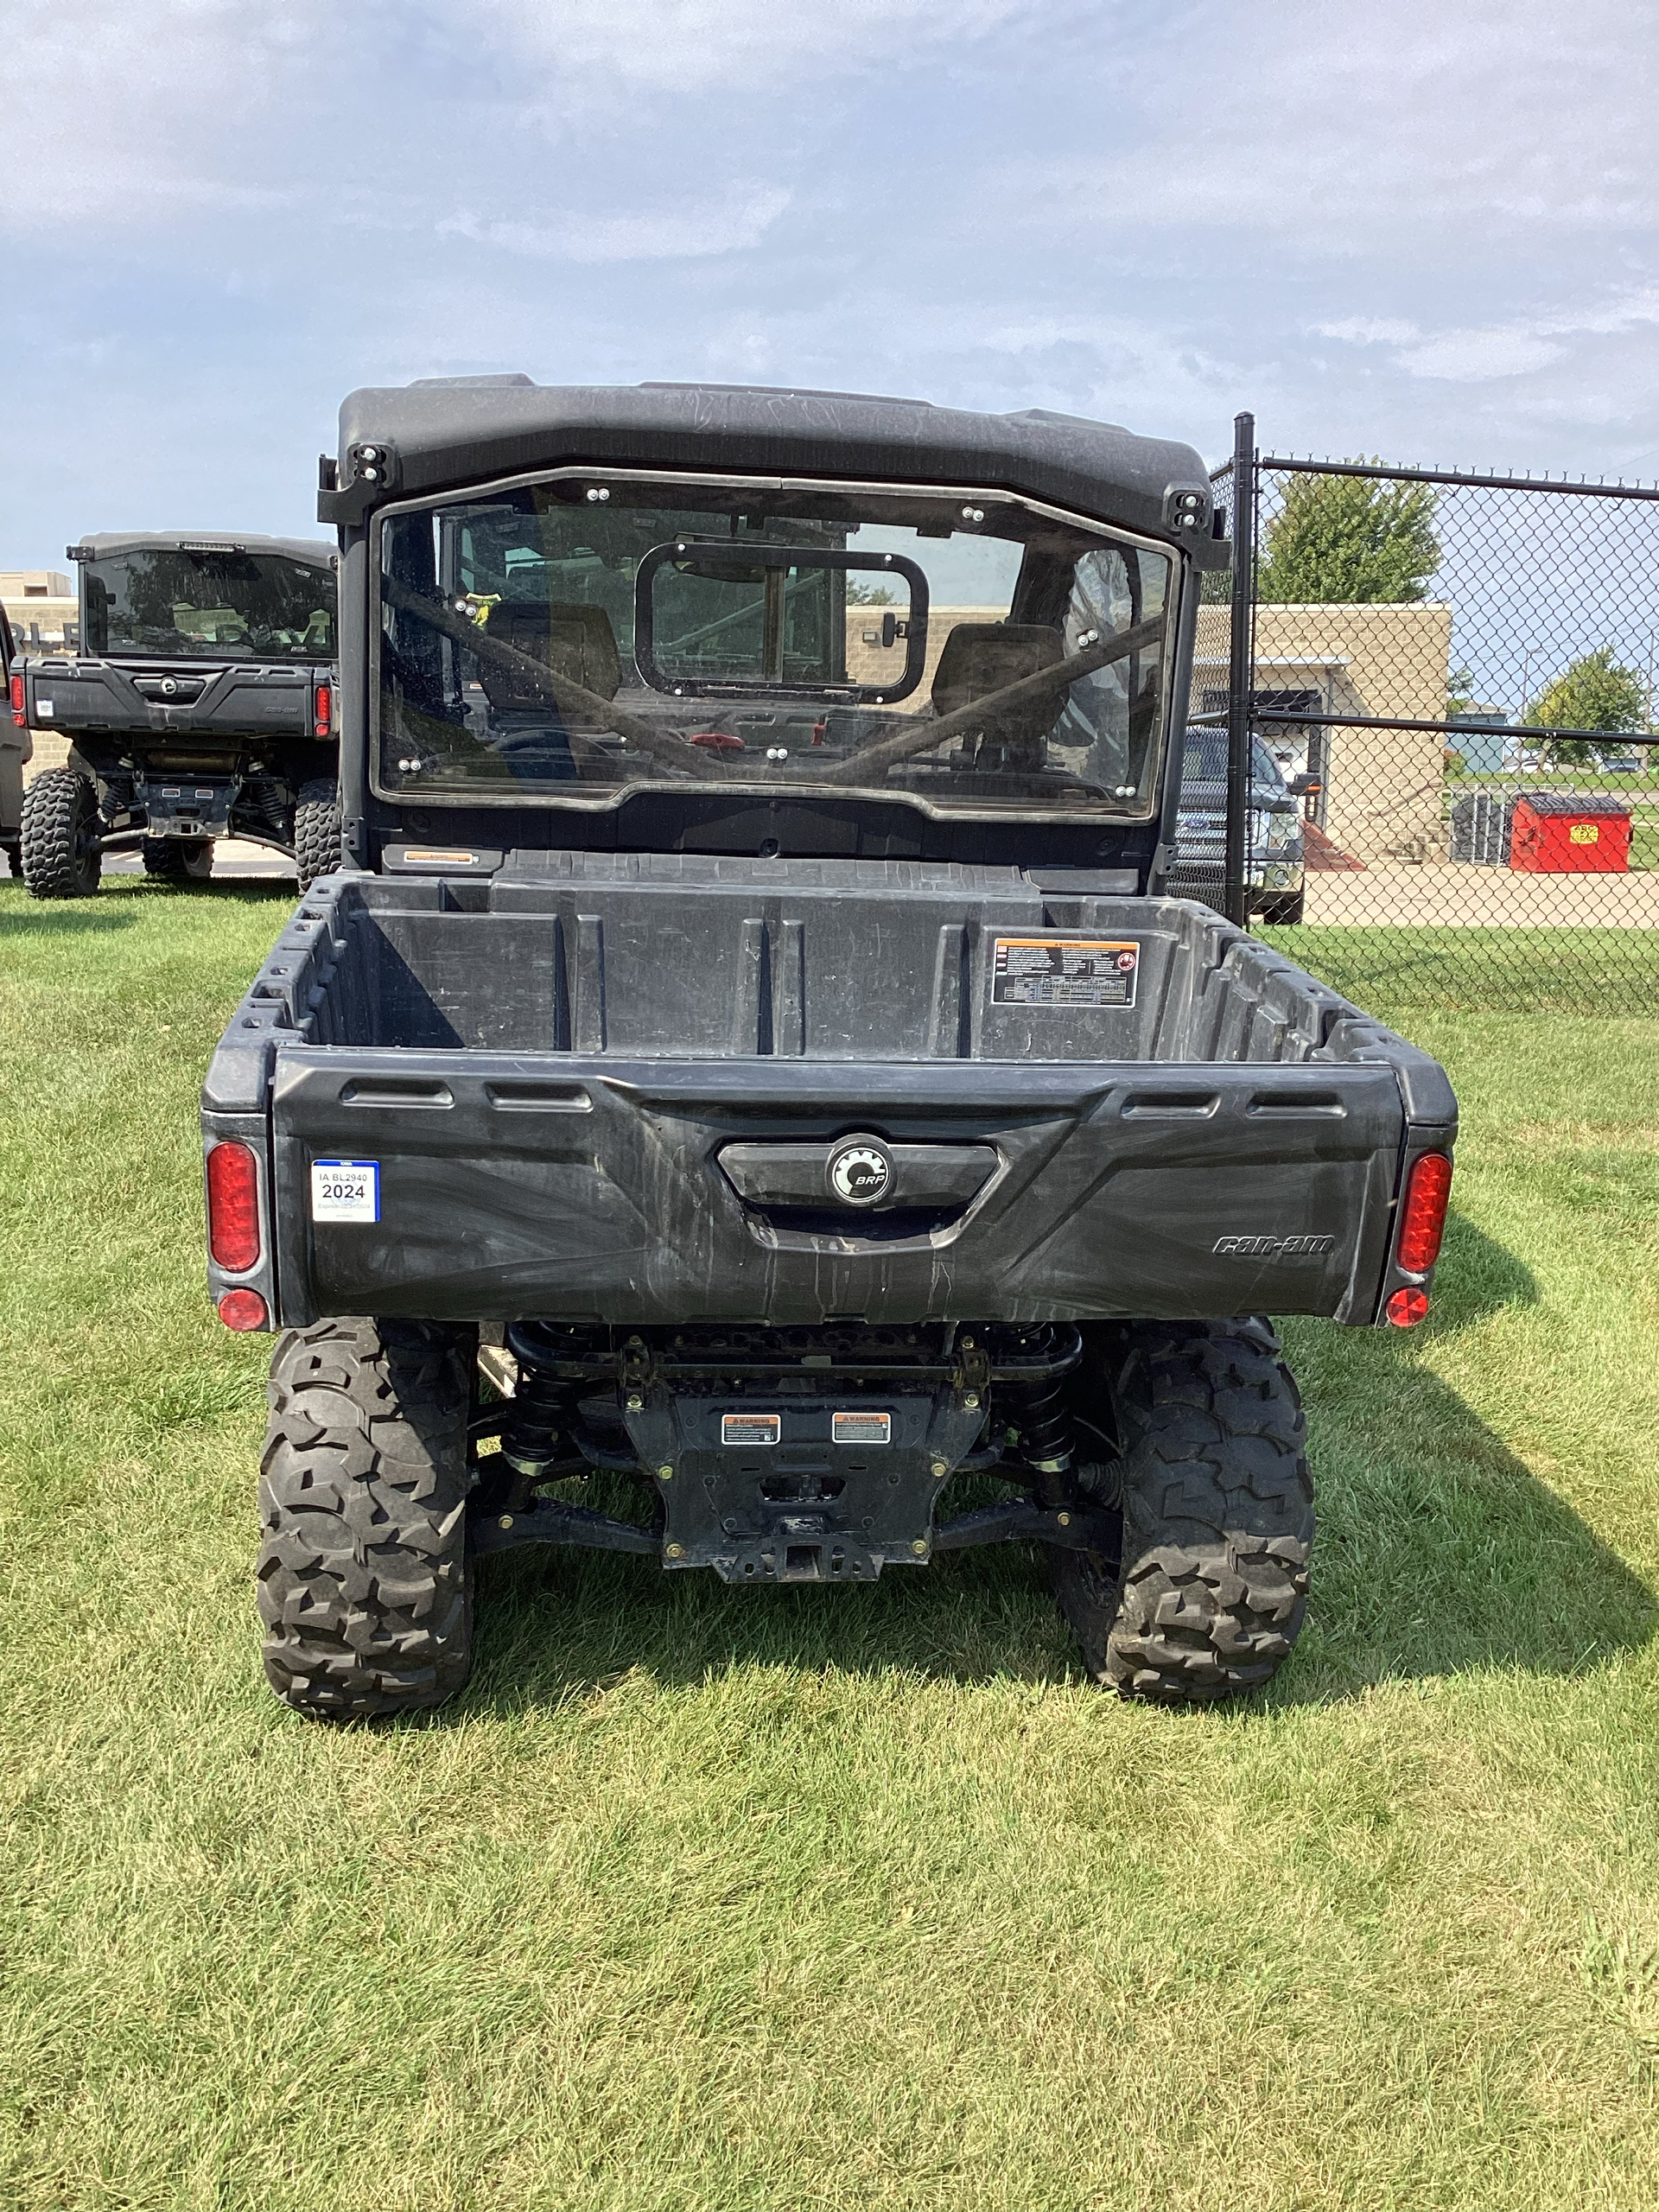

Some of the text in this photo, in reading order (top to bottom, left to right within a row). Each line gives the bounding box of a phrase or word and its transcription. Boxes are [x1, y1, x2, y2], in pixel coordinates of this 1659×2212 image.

[855, 1175, 885, 1185] BRP
[322, 1185, 365, 1198] 2024
[1212, 1235, 1335, 1255] can-am
